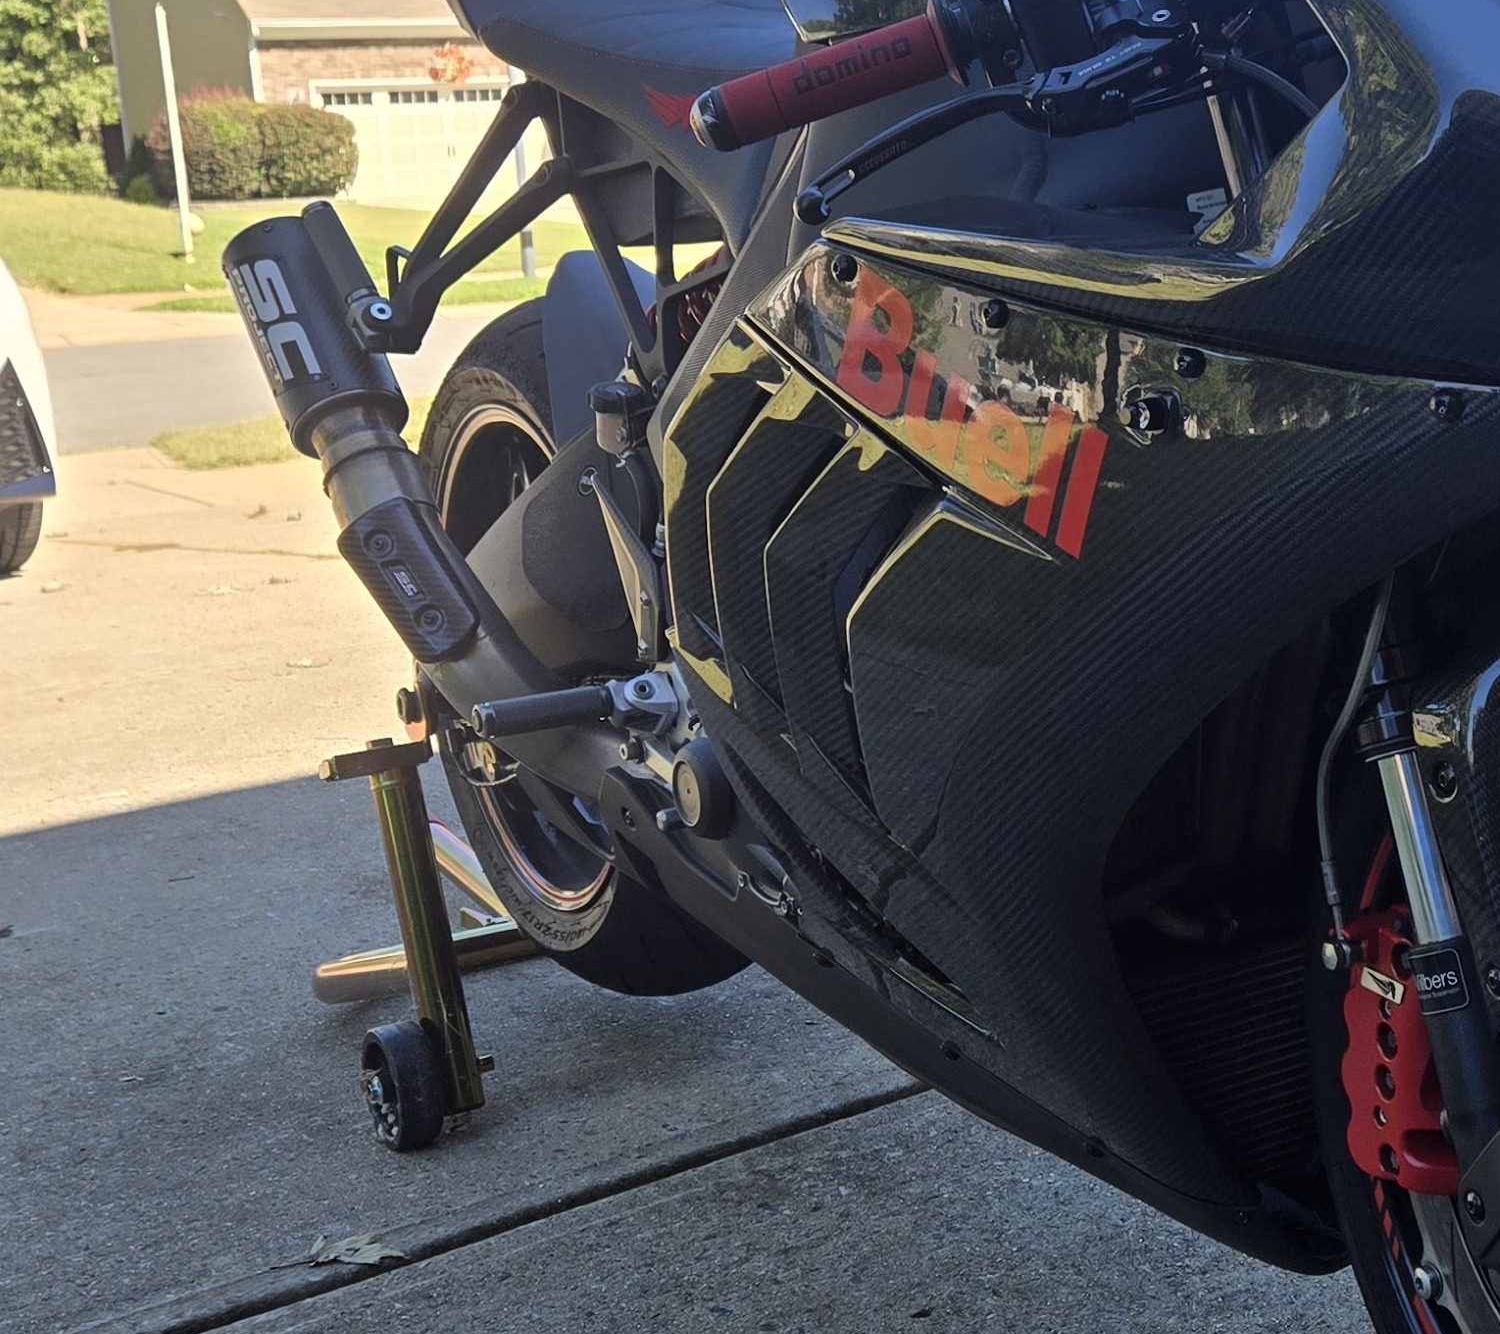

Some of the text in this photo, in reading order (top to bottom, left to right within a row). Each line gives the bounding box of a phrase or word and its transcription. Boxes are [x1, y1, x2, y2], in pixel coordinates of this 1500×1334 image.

[792, 38, 912, 96] domino
[232, 268, 283, 384] PROJECT
[240, 259, 321, 380] SC
[836, 265, 1109, 558] Buell
